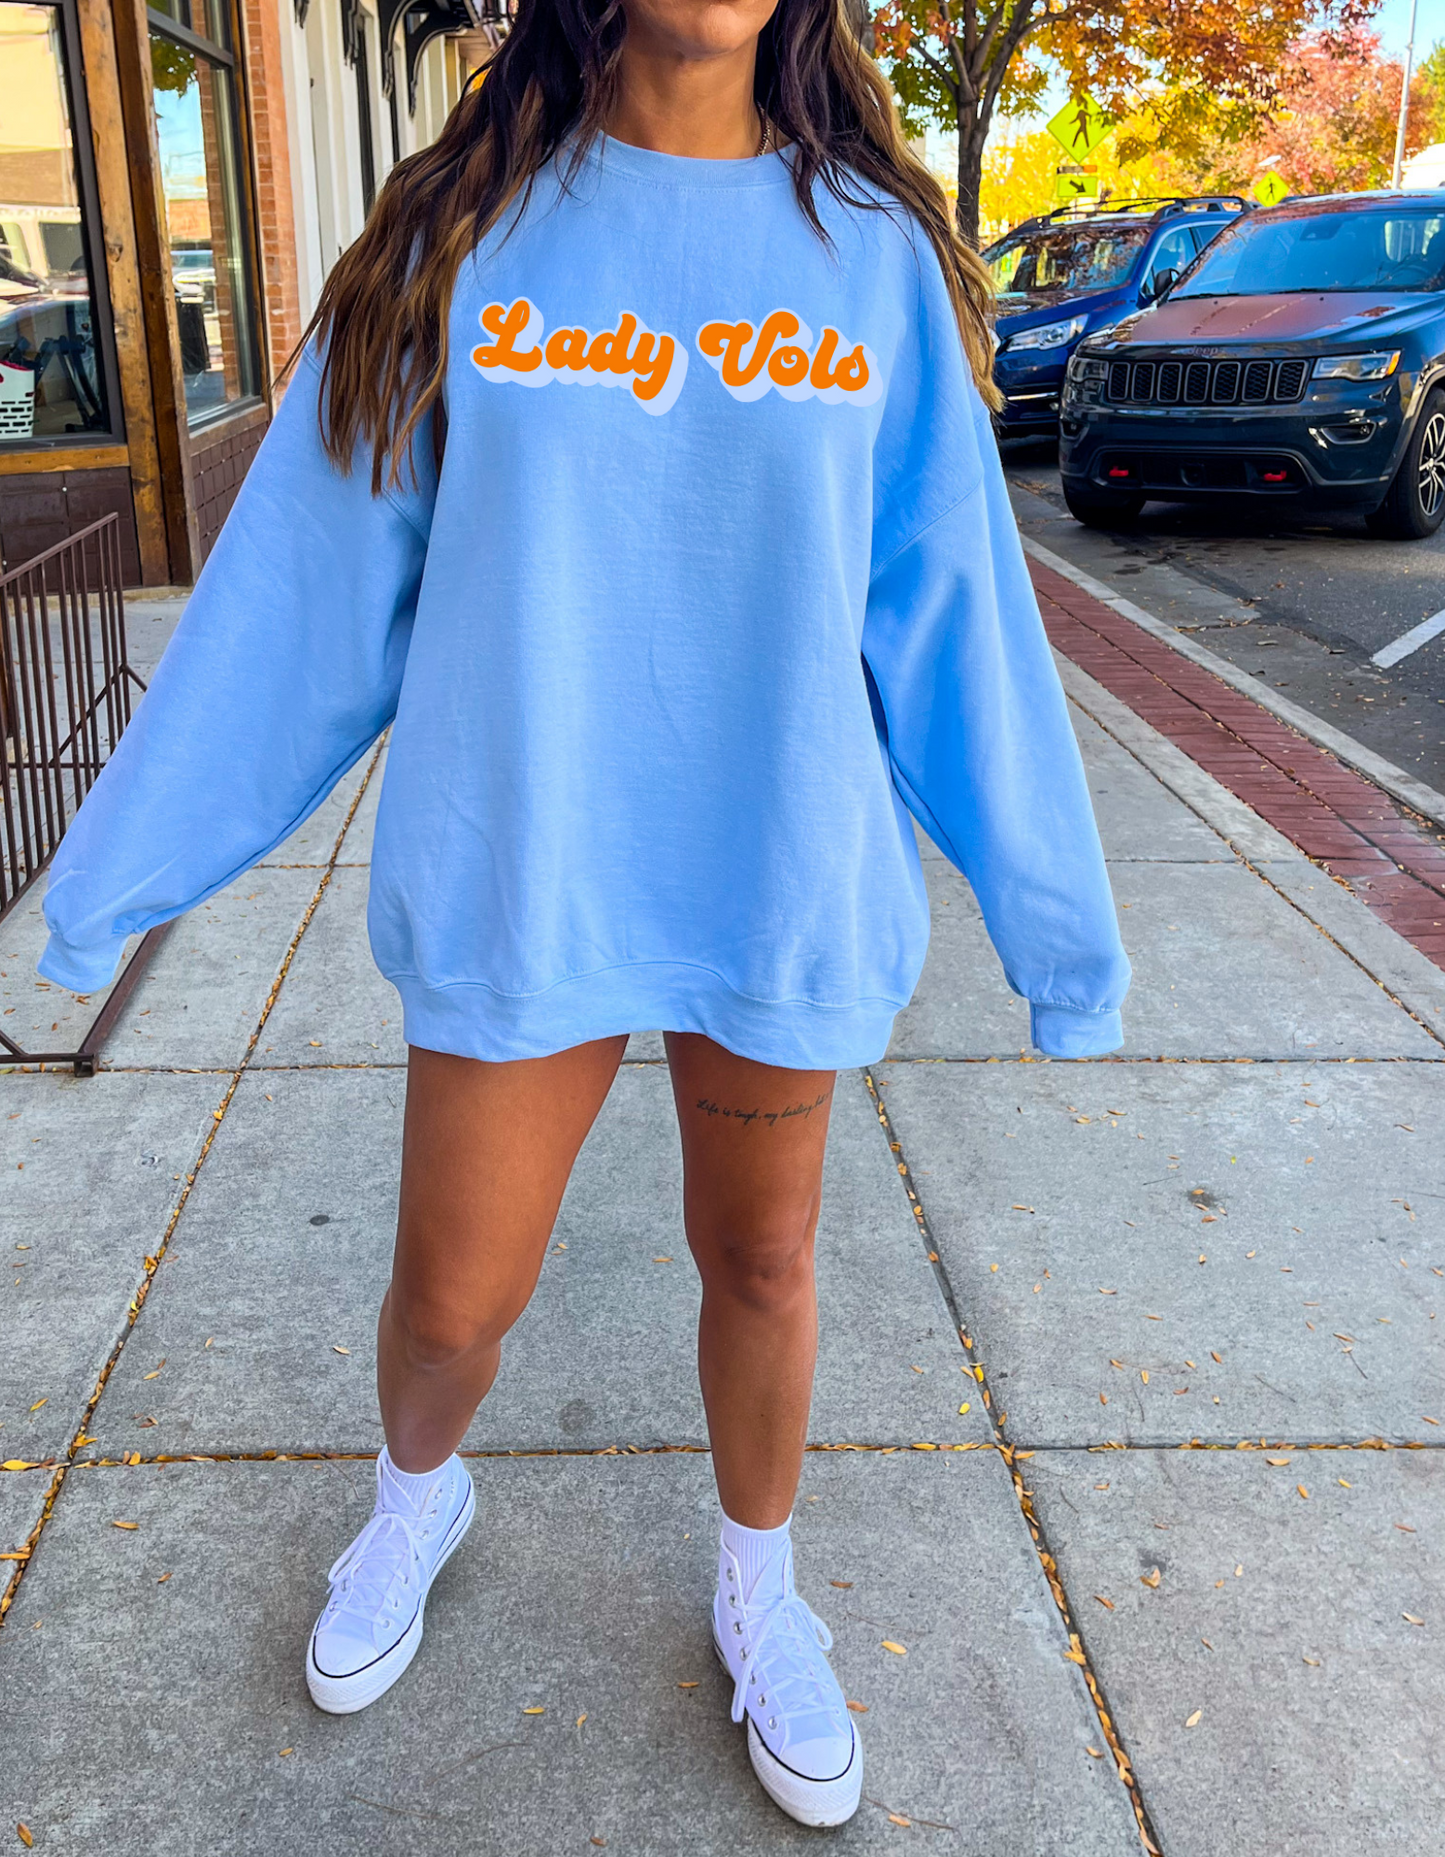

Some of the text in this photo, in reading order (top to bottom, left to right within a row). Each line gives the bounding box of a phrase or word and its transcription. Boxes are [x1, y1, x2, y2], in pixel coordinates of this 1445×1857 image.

[472, 298, 875, 406] Lady Vols
[1188, 345, 1219, 357] Jeep
[696, 1099, 719, 1116] Life
[764, 1112, 778, 1126] my
